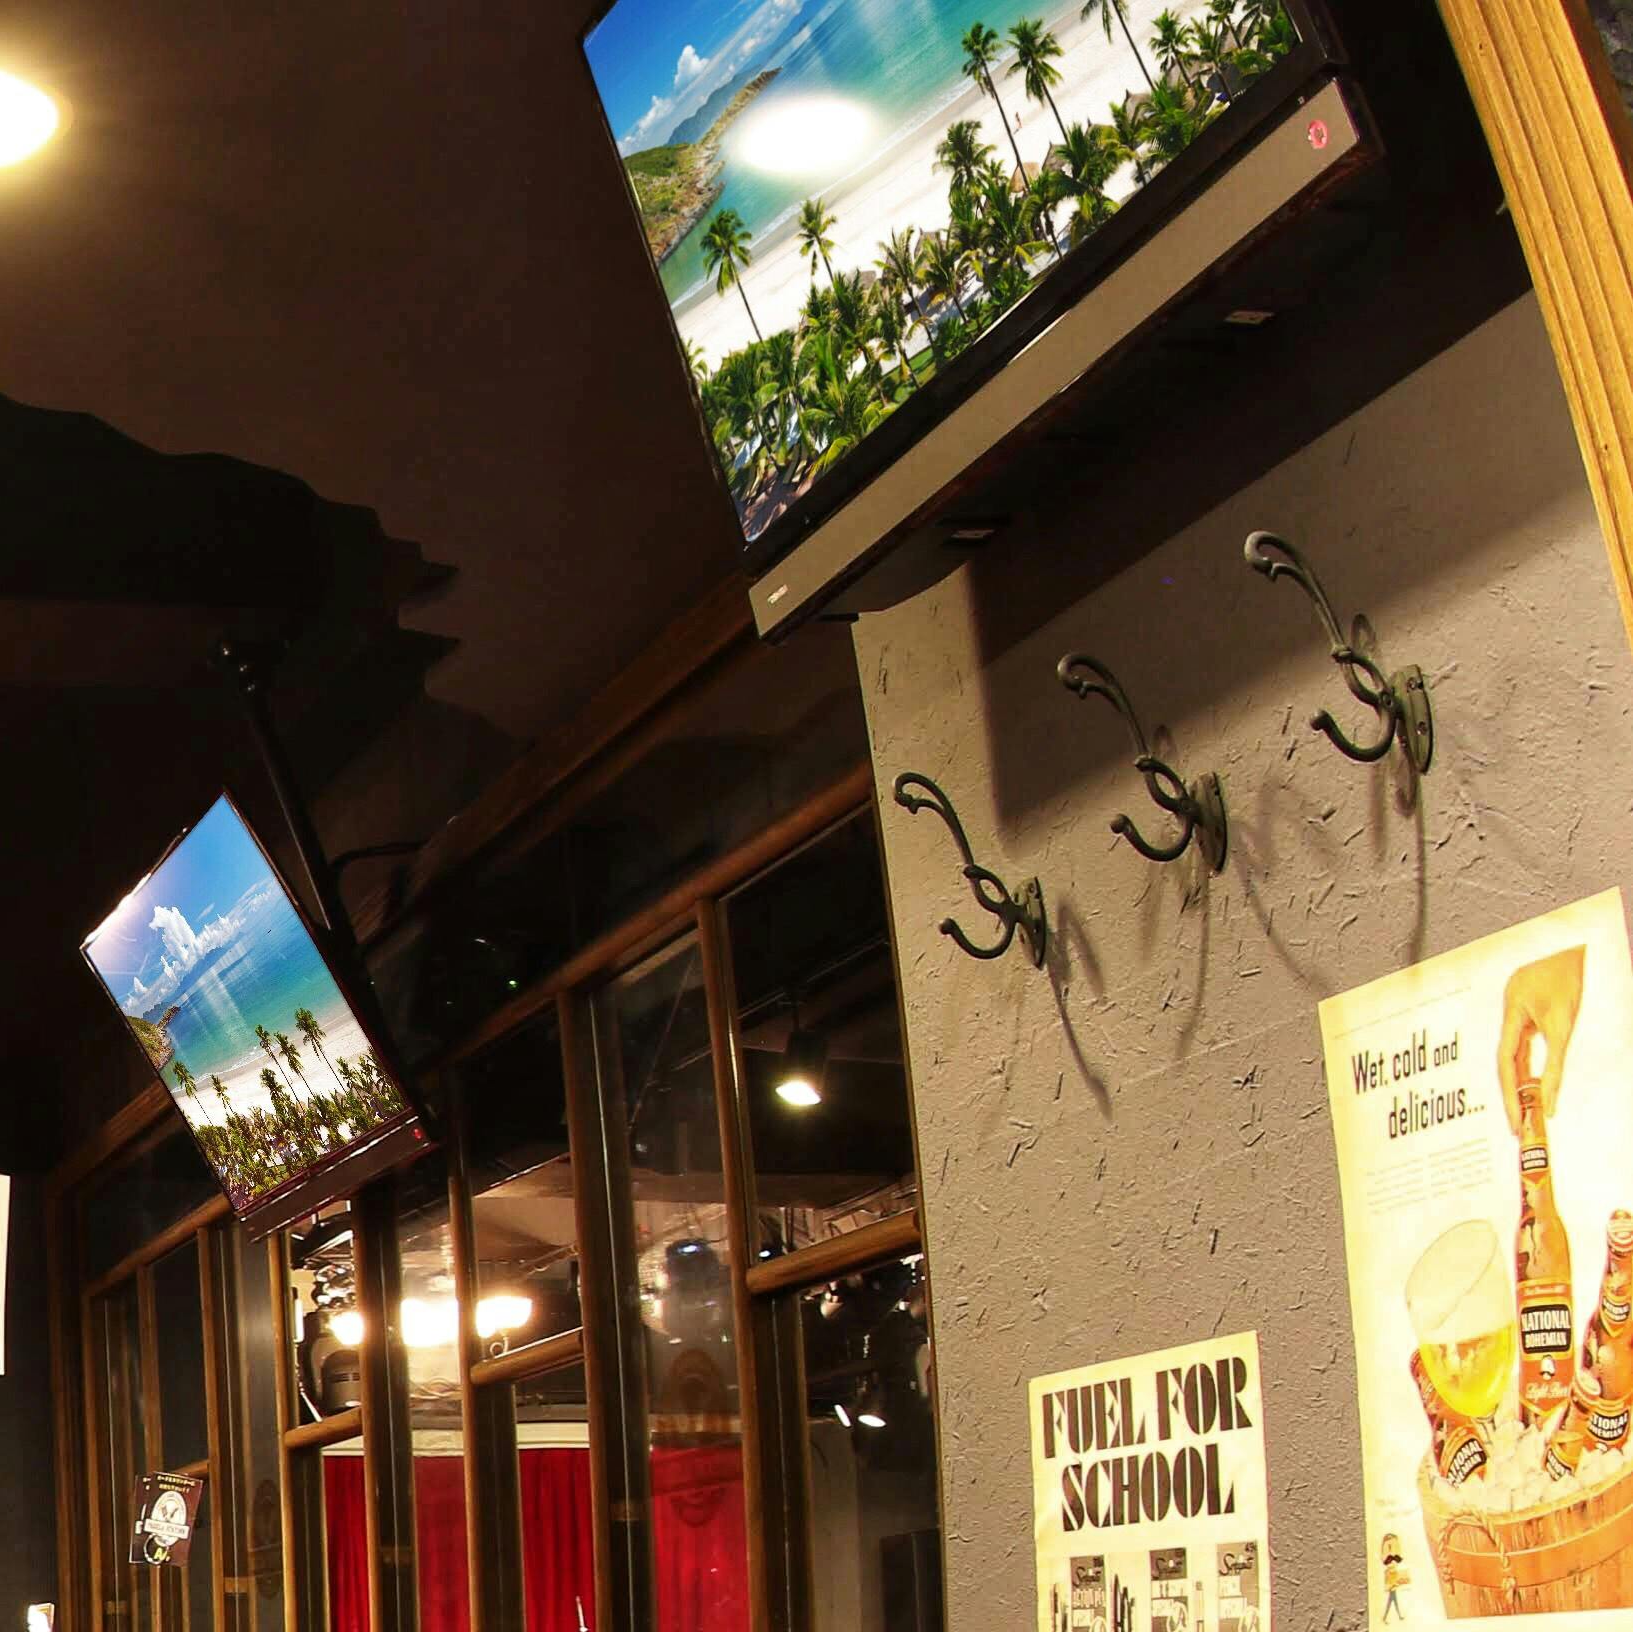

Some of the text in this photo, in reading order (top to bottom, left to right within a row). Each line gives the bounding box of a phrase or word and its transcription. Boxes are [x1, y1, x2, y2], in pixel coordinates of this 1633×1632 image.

[1393, 1028, 1427, 1081] cold
[1434, 1031, 1458, 1067] and
[1389, 1088, 1485, 1140] delicious...
[1521, 1308, 1572, 1332] NATIONAL
[1524, 1331, 1568, 1349] BOHEMIAN
[1042, 1356, 1254, 1460] FUEL FOR
[1592, 1409, 1628, 1428] TIONAL
[1062, 1443, 1235, 1532] SCHOOL
